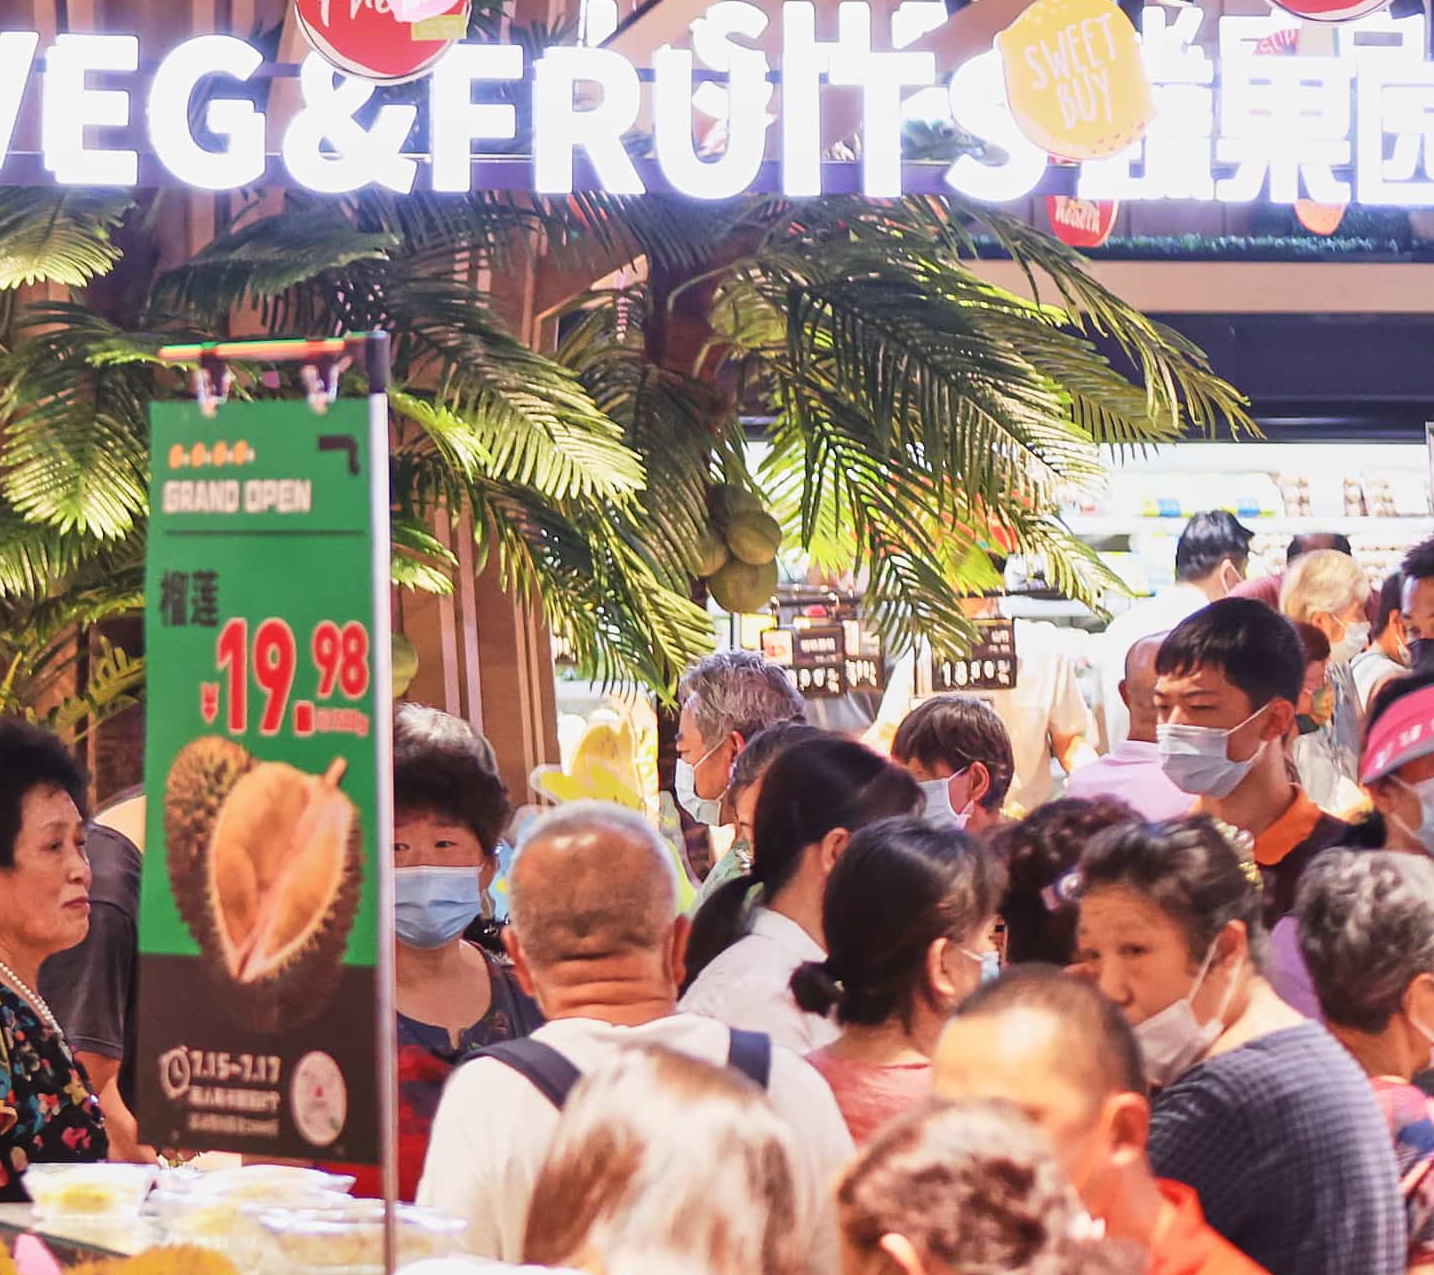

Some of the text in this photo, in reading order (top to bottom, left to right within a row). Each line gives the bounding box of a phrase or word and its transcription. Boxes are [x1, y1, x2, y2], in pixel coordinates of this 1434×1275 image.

[1024, 13, 1118, 91] SWEET
[1054, 67, 1114, 131] BUY
[162, 480, 311, 514] GRAND OPEN
